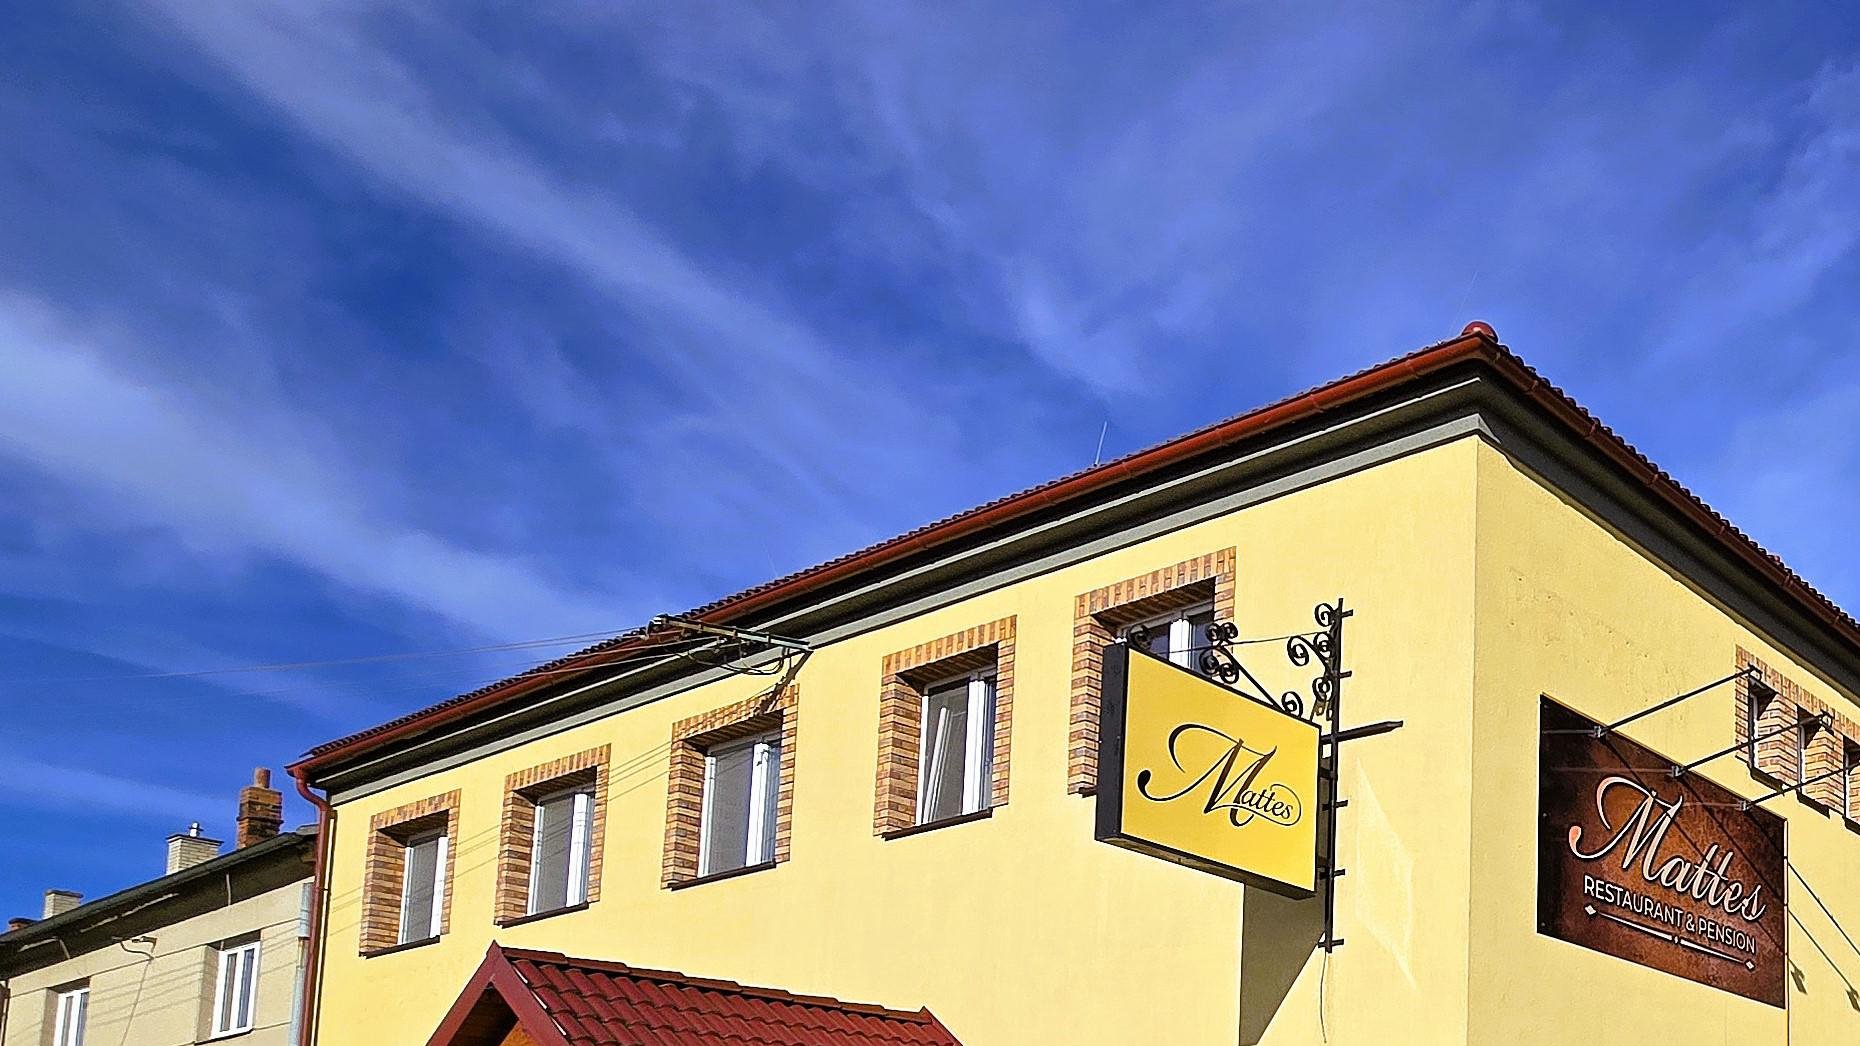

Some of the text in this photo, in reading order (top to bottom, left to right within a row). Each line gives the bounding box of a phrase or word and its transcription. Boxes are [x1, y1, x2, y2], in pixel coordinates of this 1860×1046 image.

[1137, 723, 1302, 827] Mattes
[1568, 776, 1767, 921] Mattes
[1583, 874, 1757, 954] RESTAURANT & PENSION
